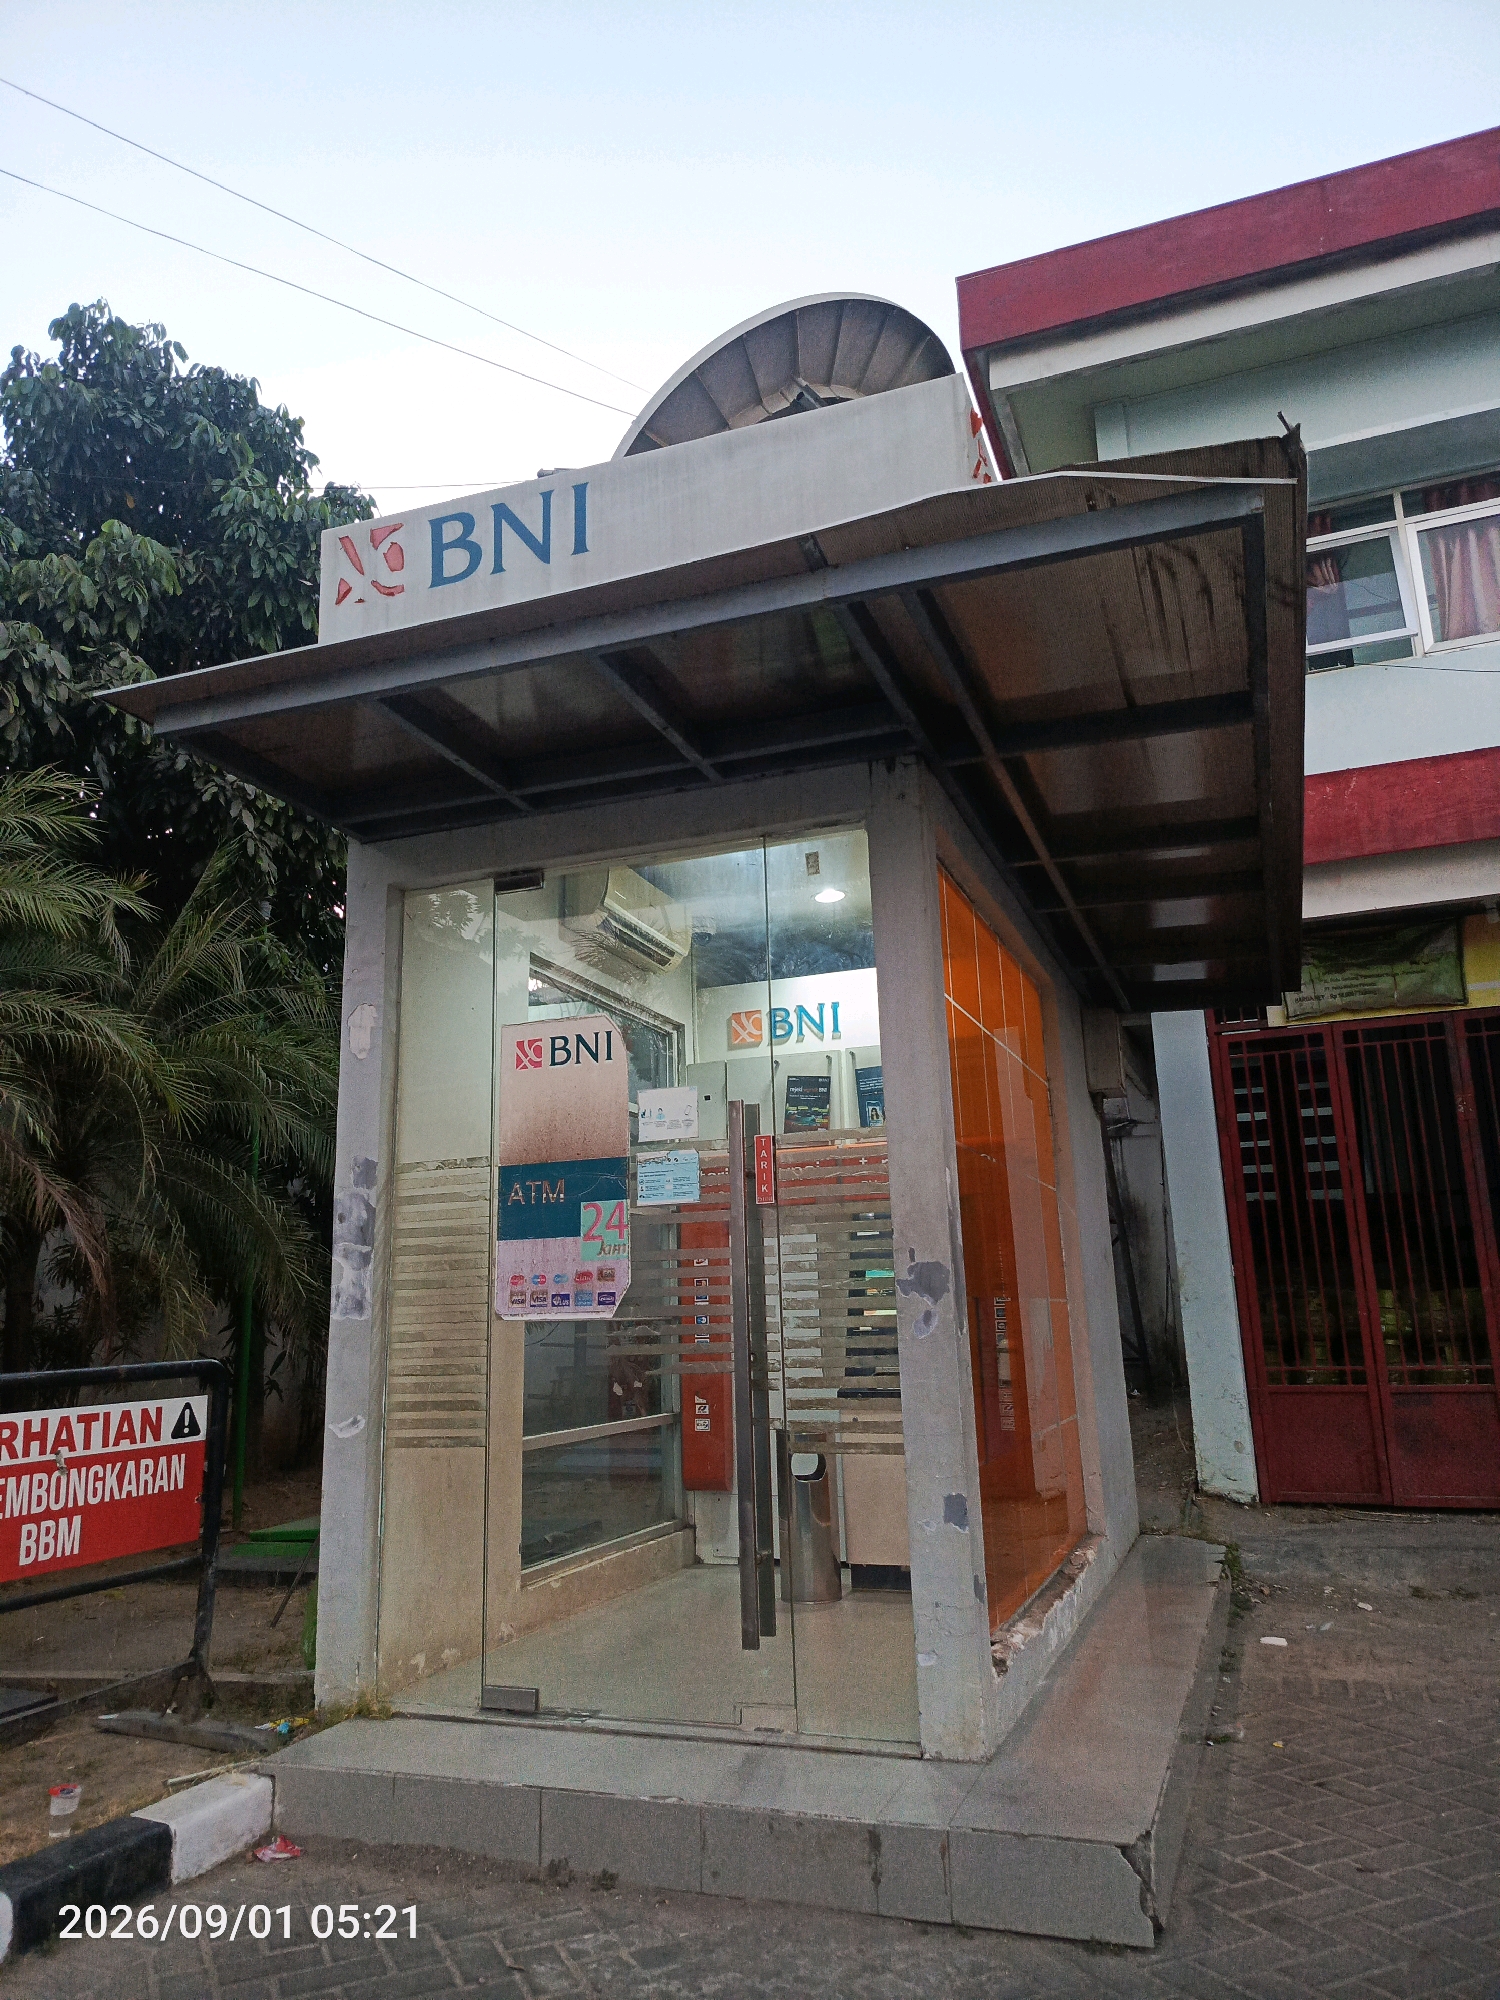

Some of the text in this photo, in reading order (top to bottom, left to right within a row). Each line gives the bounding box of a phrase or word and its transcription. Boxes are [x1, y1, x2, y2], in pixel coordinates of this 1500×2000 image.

[428, 482, 590, 589] BNI
[769, 1001, 840, 1043] BNI
[549, 1030, 613, 1067] BNI
[760, 1138, 768, 1193] TARIK
[507, 1178, 565, 1206] ATM
[583, 1201, 629, 1242] 24
[532, 1295, 547, 1303] VISA
[0, 1406, 163, 1462] RHATIAN
[18, 1514, 82, 1566] BBM
